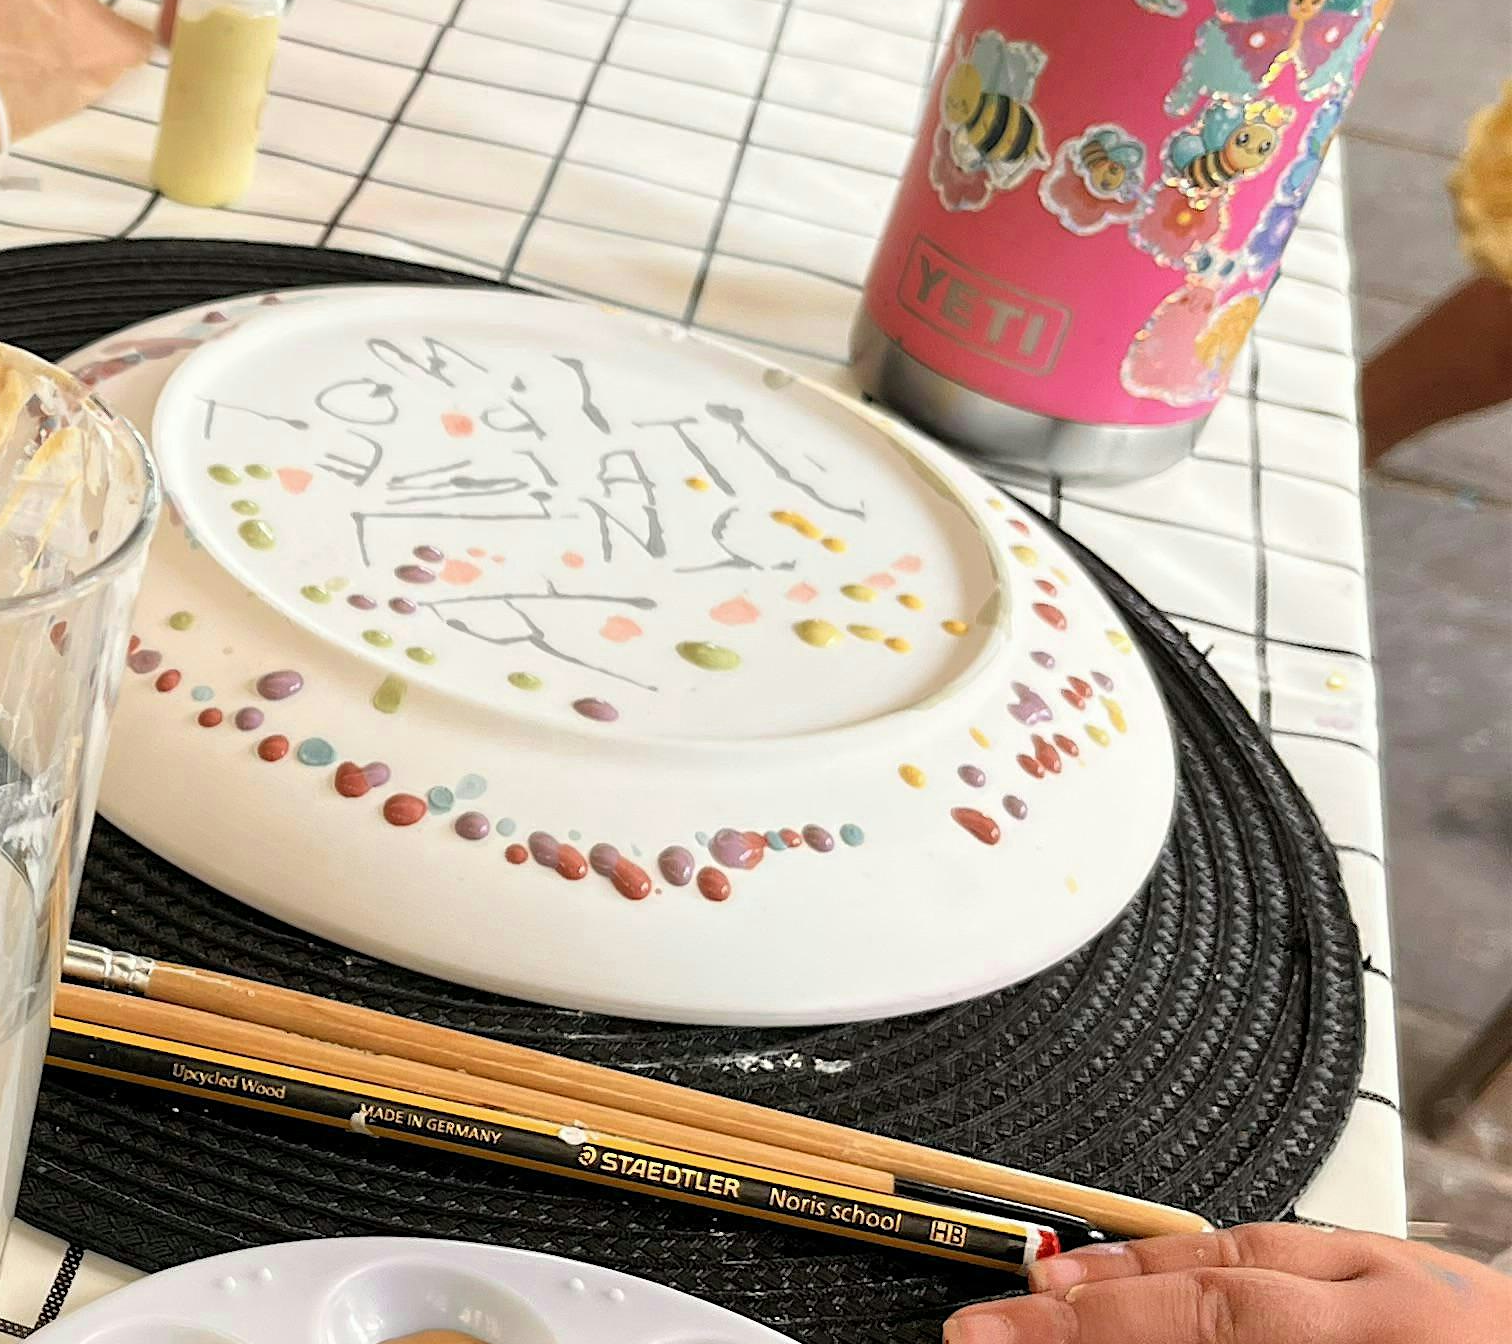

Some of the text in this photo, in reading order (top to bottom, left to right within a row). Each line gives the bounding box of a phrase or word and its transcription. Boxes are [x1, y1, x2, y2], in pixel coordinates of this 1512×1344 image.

[918, 256, 1046, 356] YETI
[172, 1062, 287, 1100] Upcycled Wood
[360, 1103, 503, 1145] MADE IN GERMANY
[600, 1152, 967, 1248] STAEDTLER Noris school HB
